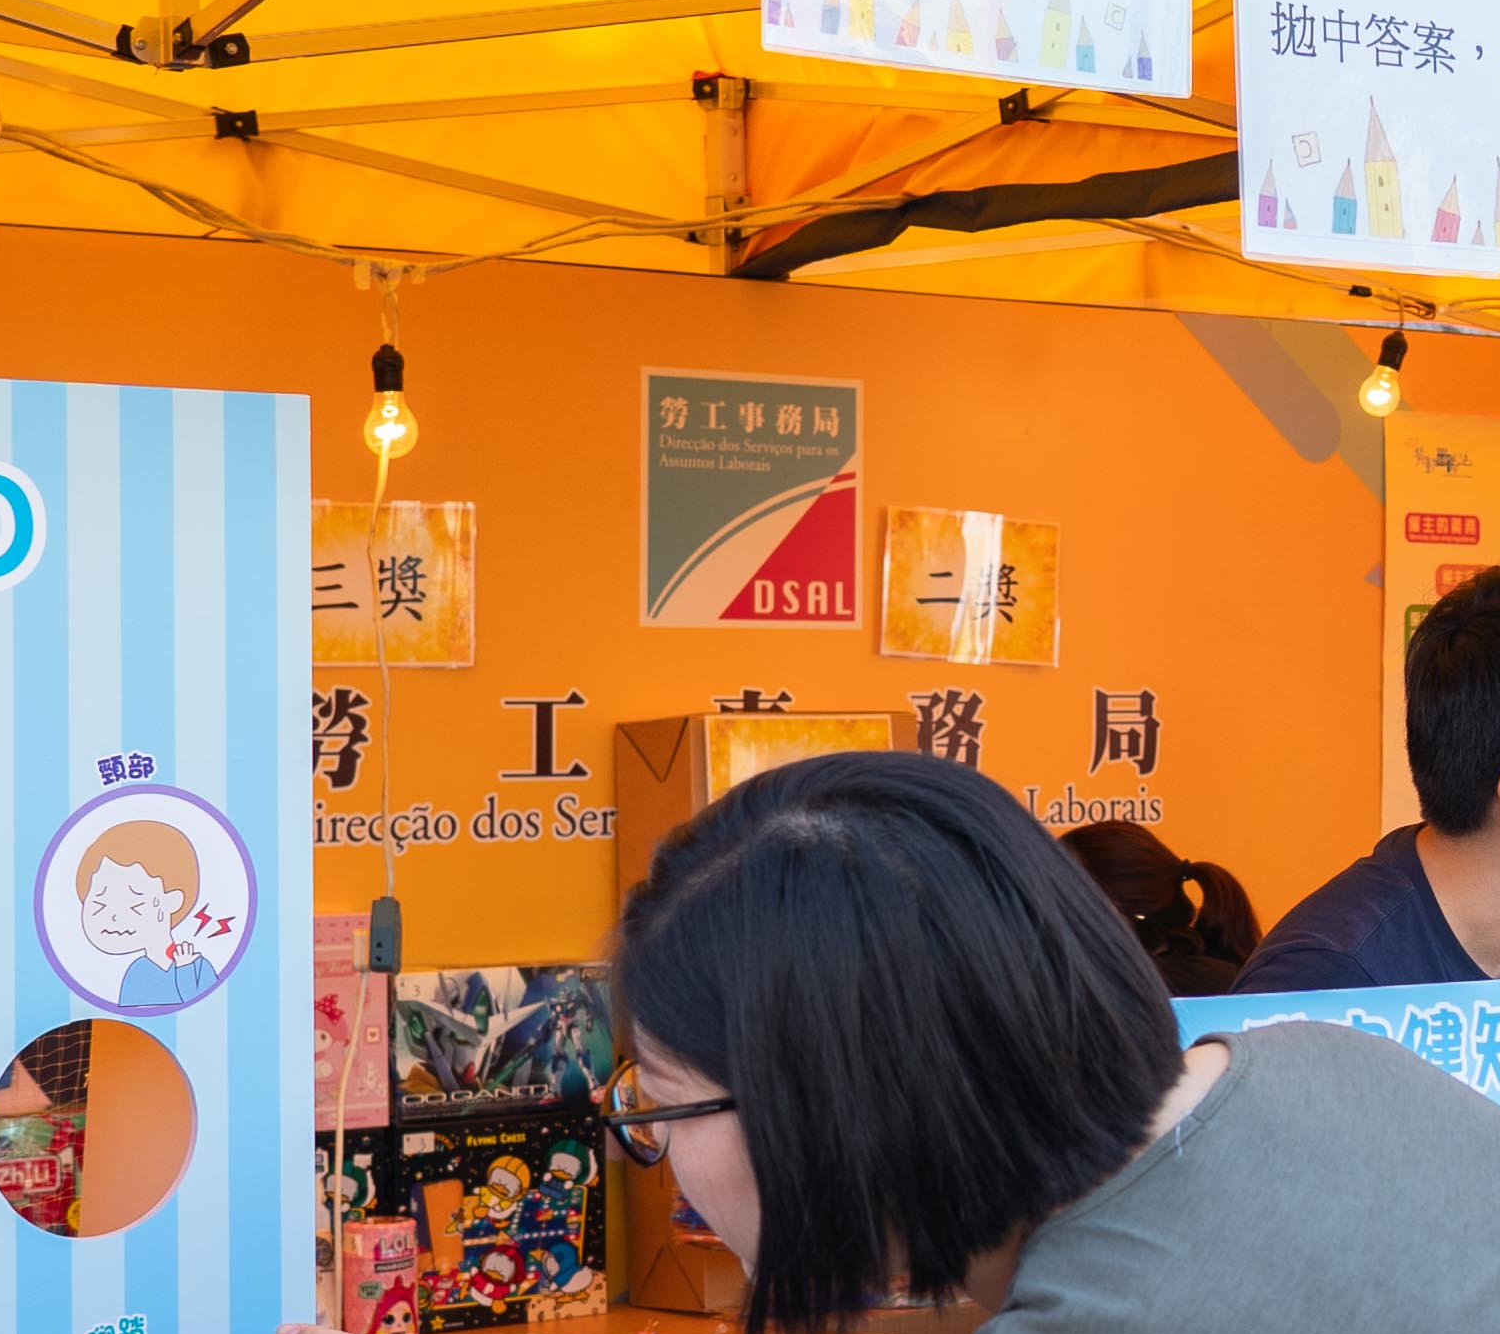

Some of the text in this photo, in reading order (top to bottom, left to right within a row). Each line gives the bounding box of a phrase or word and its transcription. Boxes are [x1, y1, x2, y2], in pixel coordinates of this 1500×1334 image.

[660, 396, 840, 439] 勞工事務局
[659, 453, 771, 472] Assuntos Laborais
[718, 437, 740, 452] dos
[797, 443, 823, 459] para
[826, 446, 840, 457] os
[753, 579, 853, 616] DSAL
[915, 562, 1020, 624] 二獎
[97, 752, 157, 785] 頸部
[315, 783, 1163, 849] irecção dos Ser Laborais
